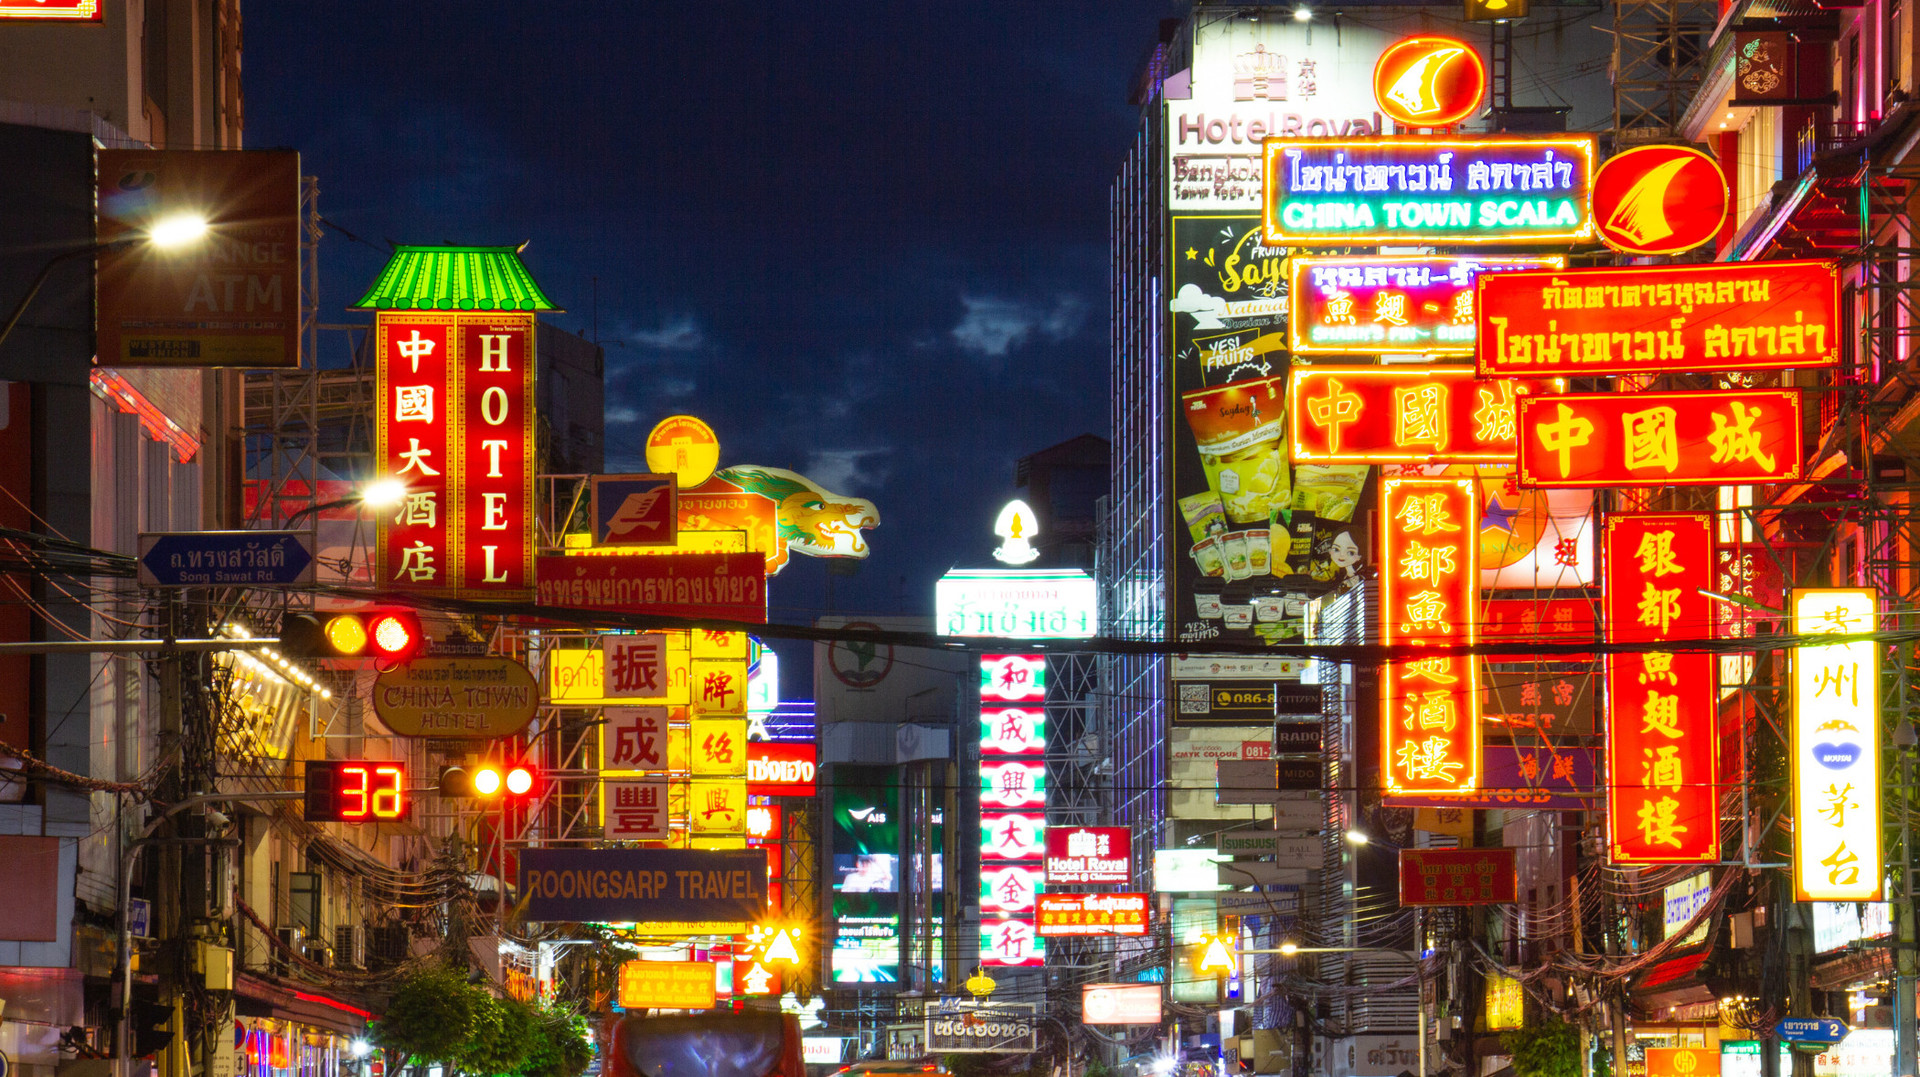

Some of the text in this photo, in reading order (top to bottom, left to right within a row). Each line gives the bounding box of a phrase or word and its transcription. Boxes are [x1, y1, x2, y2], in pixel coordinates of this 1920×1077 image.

[1179, 111, 1383, 145] Hotel Royal
[1173, 155, 1261, 189] Bangkok
[1285, 149, 1573, 192] ไชน่าทาวน์ สกาล่า
[1282, 200, 1578, 229] CHINA TOWN SCALA
[184, 274, 283, 313] ATM
[1208, 336, 1241, 352] YES!
[1490, 311, 1827, 363] ไชน่าทาวน์ สกาล่า
[1206, 347, 1254, 373] FRUITS
[1307, 378, 1516, 454] 中國城
[1536, 402, 1776, 478] 中國城
[394, 330, 441, 583] 中國大酒店
[478, 334, 511, 583] HOTEL
[179, 570, 277, 583] Song Sawat Rd.
[1185, 619, 1210, 633] YES!
[1394, 492, 1464, 783] 銀都魚翅酒樓
[383, 686, 530, 711] CHINA TOWN
[1279, 694, 1319, 704] CITIZEN
[1634, 529, 1687, 849] 銀都魚翅酒樓
[420, 713, 490, 730] HOTEL
[611, 643, 660, 834] 振成豐
[1280, 731, 1320, 742] RADO
[1811, 605, 1861, 886] 貴州 茅台
[867, 813, 886, 823] AIS
[996, 661, 1029, 958] 和成興大金行
[1048, 857, 1128, 871] Hotel Royal
[1048, 873, 1128, 882] Bangkok @ Chinatown
[527, 870, 760, 899] ROONGSARP TRAVEL
[1221, 897, 1270, 909] BROADWAY
[1829, 1023, 1839, 1036] 2
